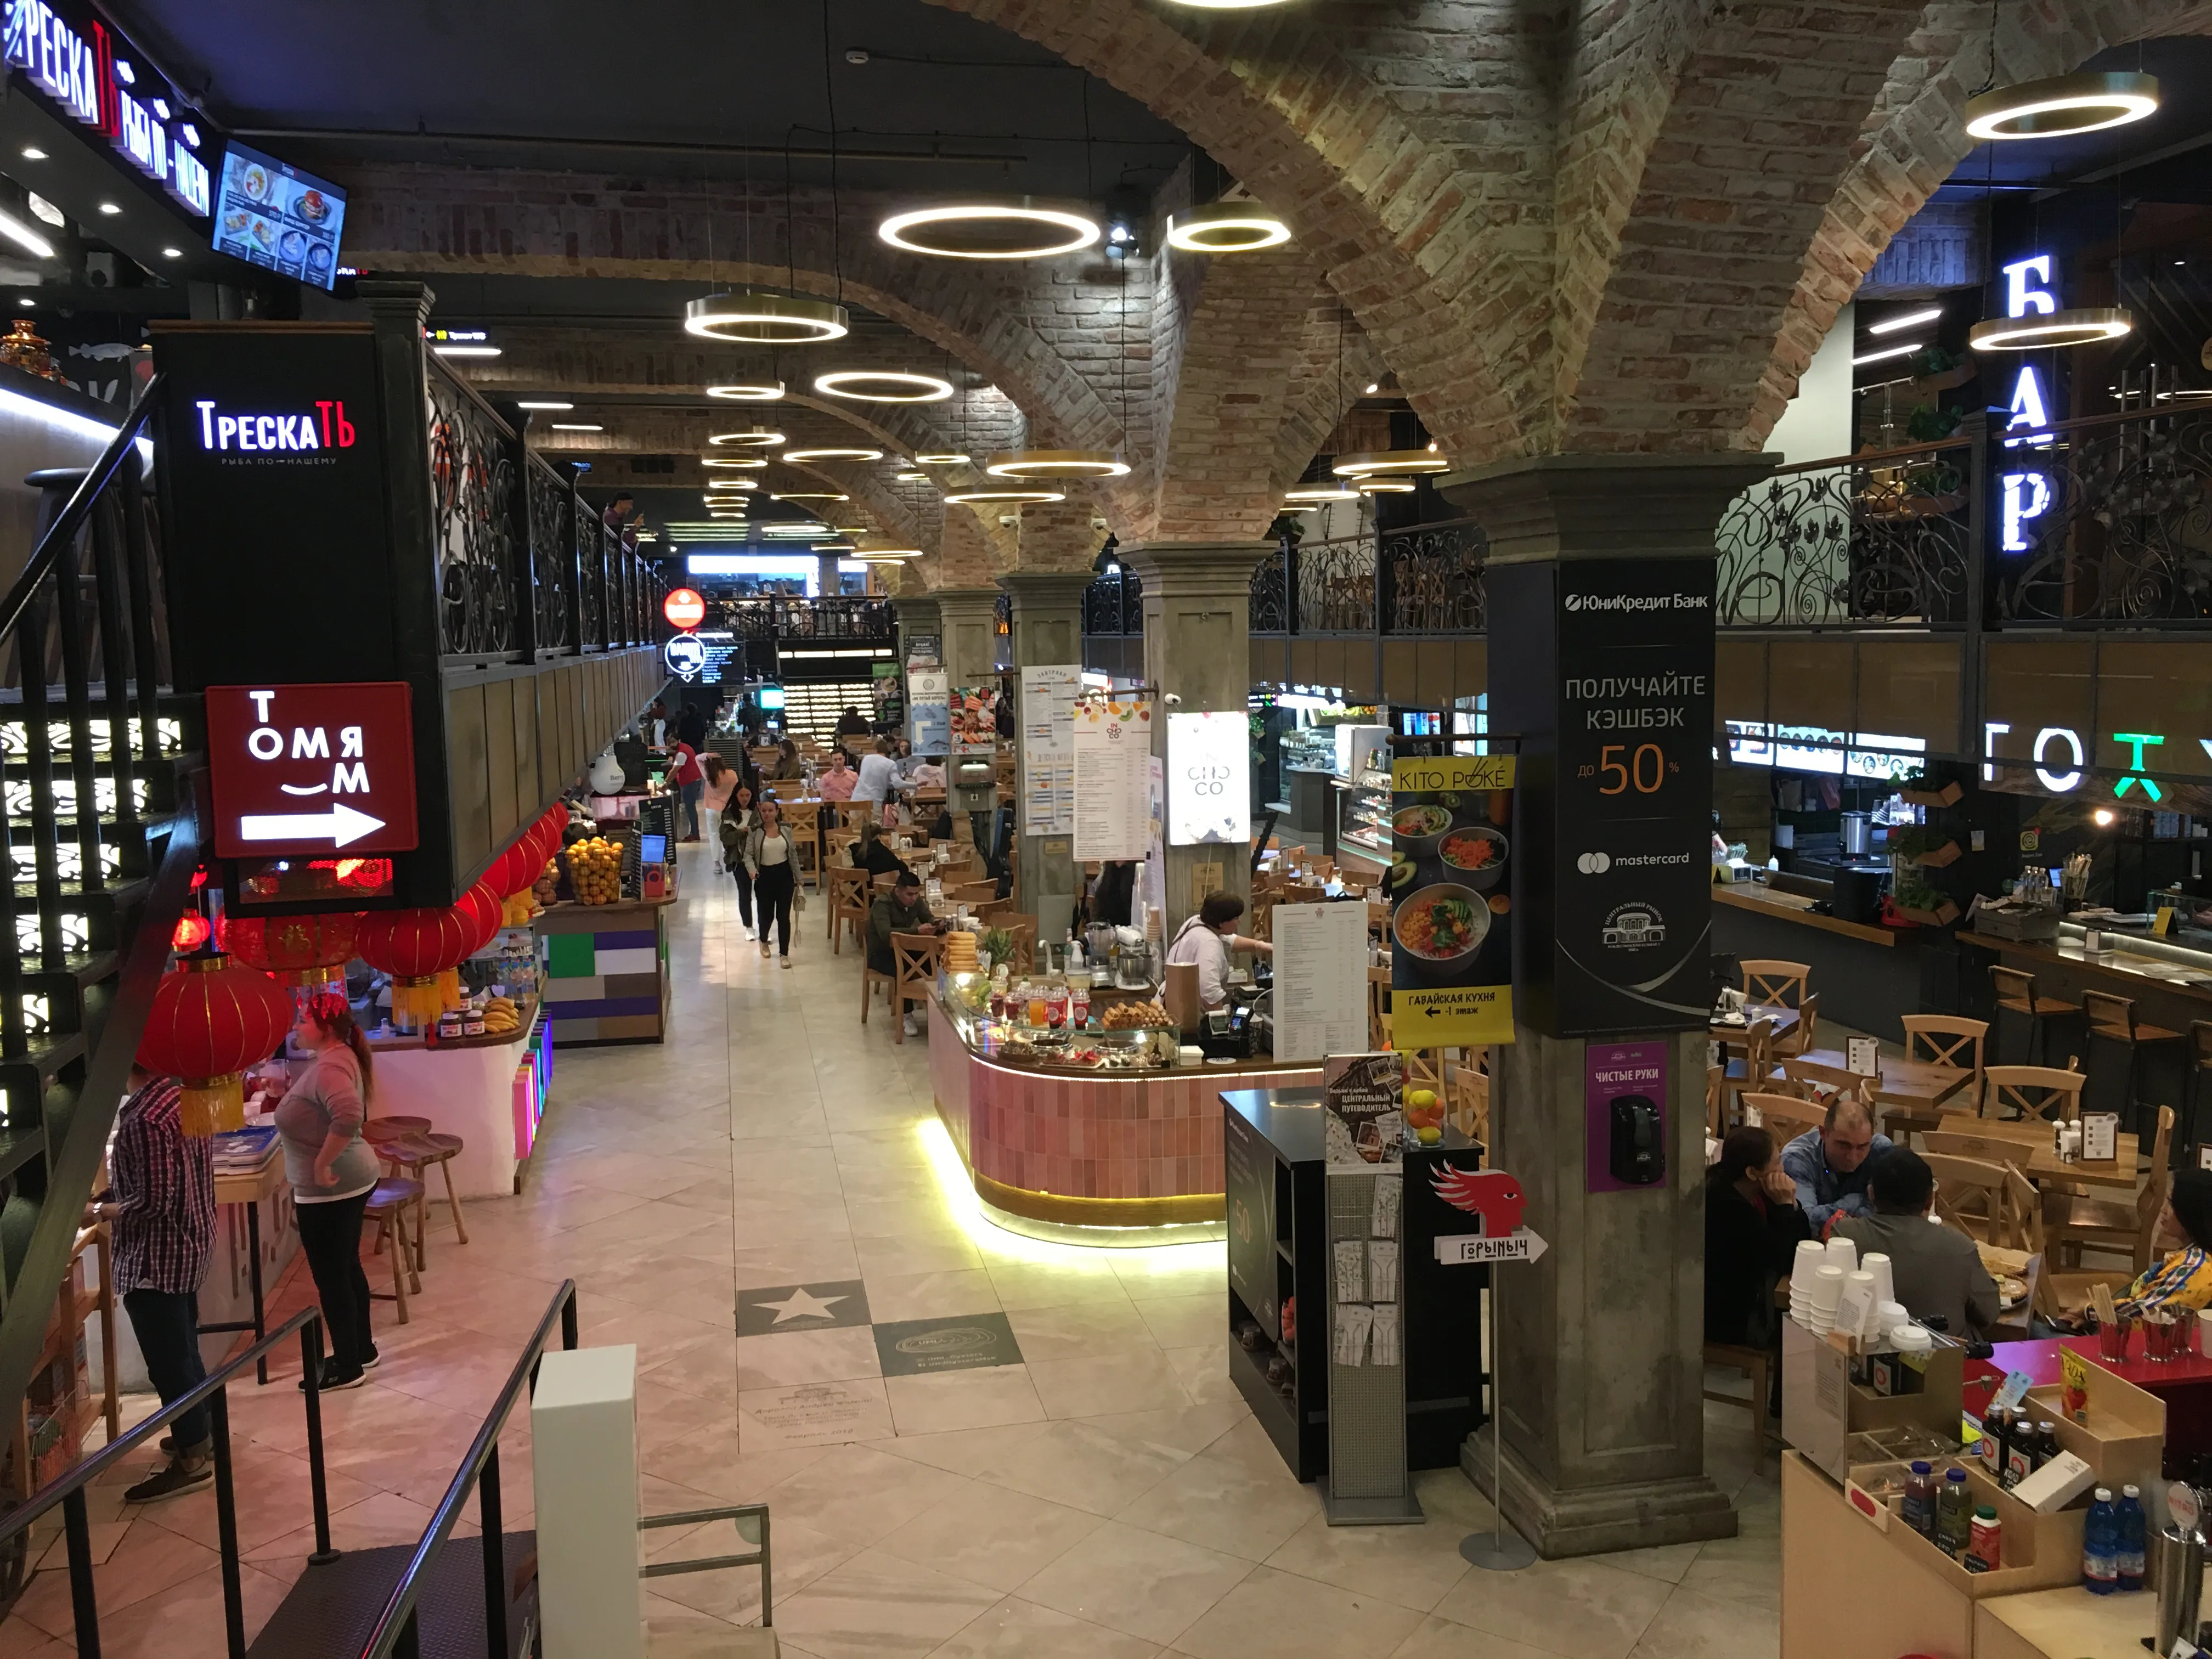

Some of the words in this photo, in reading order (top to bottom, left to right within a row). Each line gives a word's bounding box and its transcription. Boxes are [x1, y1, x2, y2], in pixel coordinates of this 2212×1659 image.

[2002, 255, 2054, 551] БАР
[1583, 594, 1671, 613] ЮниКредит
[1673, 593, 1708, 608] Банк
[1566, 670, 1706, 699] ПОЛУЧАЙТЕ
[1587, 707, 1684, 730] КЭШБЭК
[1599, 743, 1663, 794] 50
[1400, 772, 1444, 790] KITO
[1616, 853, 1689, 866] mastercard
[1605, 902, 1646, 926] ЦЕНТРАЛЬНЫЙ
[1646, 903, 1663, 923] РЫНОК
[1408, 992, 1463, 1006] ГАВАЙСКАЯ
[1465, 992, 1496, 1003] КУХНЯ
[1595, 1070, 1633, 1082] ЧИСТЫЕ
[1635, 1069, 1658, 1080] РУКИ
[1342, 1094, 1390, 1103] ЦЕНТРАЛЬНЫЙ
[1342, 1104, 1391, 1113] ПУТЕВОДИТЕЛЬ
